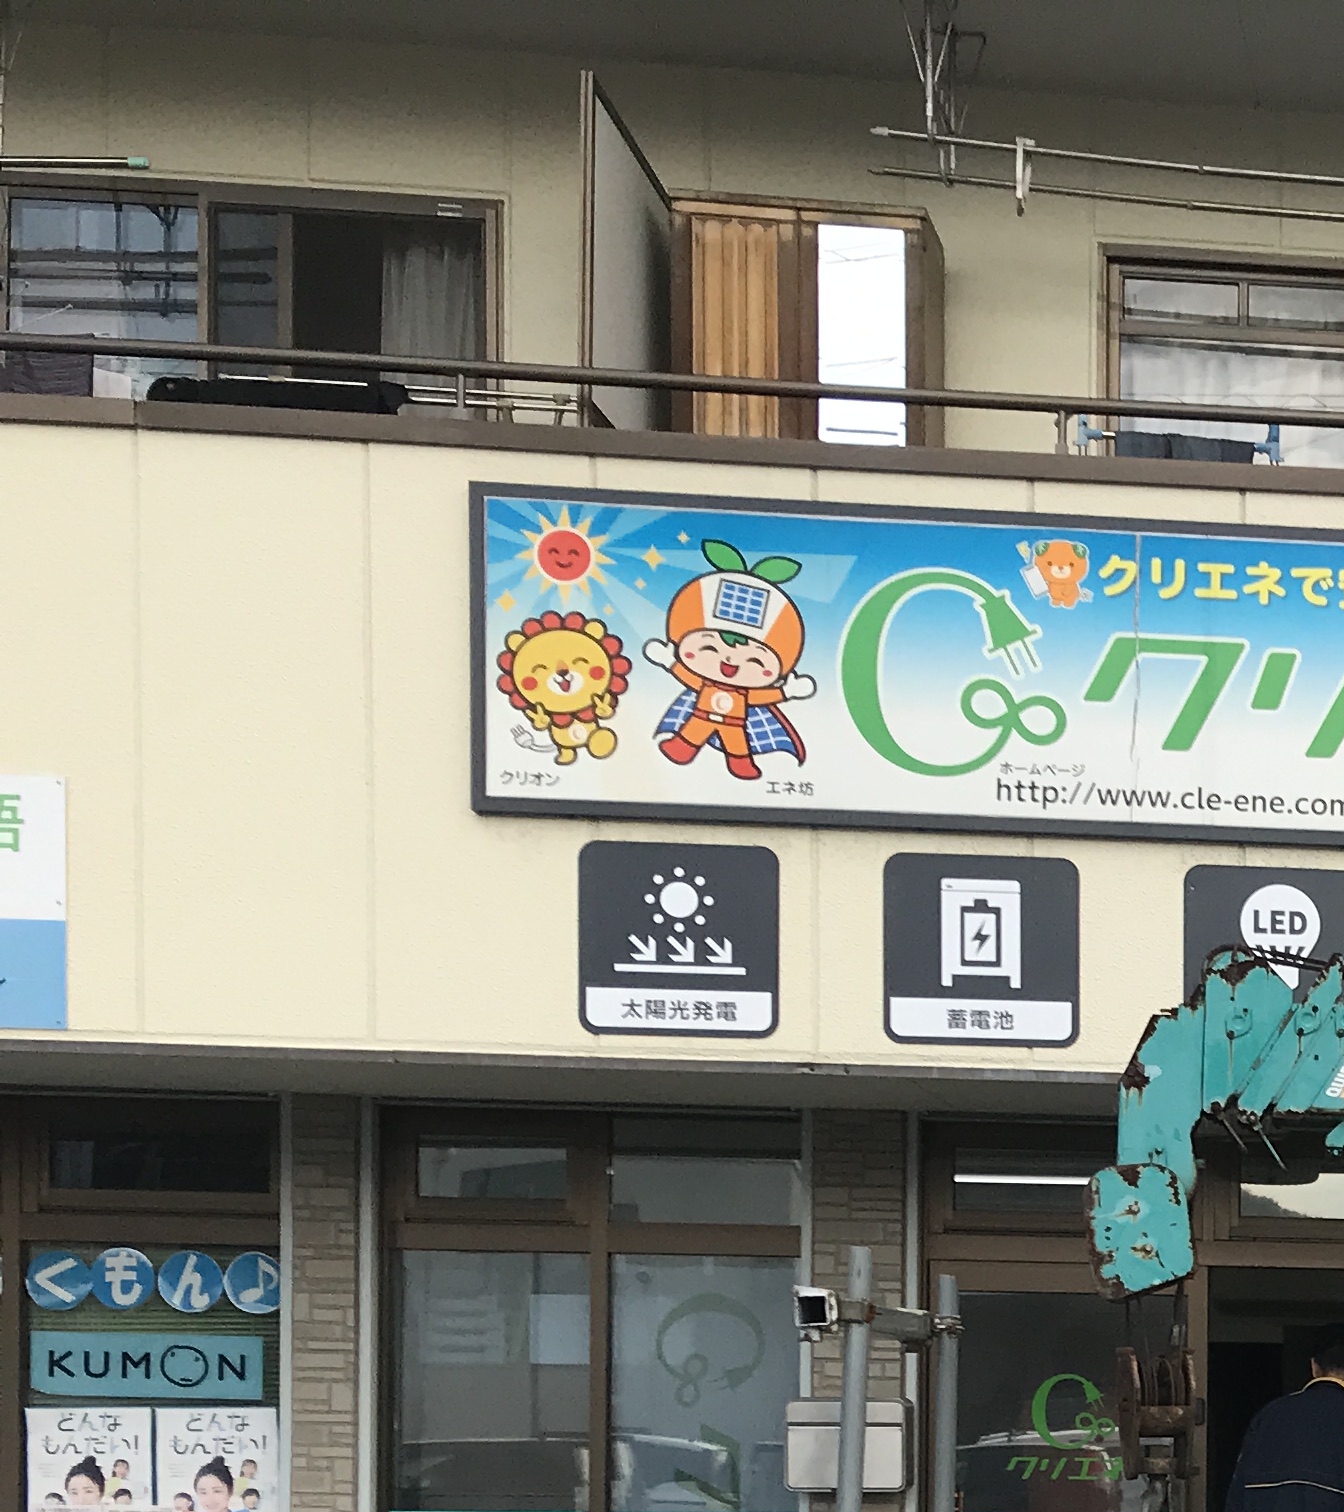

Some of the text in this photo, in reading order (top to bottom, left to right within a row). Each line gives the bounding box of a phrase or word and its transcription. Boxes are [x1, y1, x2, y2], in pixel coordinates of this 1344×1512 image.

[499, 769, 560, 787] クリオン
[999, 762, 1085, 778] ホームページ
[766, 780, 814, 797] エネ坊
[1253, 909, 1308, 935] LED
[621, 999, 738, 1023] 太陽光発電
[946, 1008, 1015, 1031] 蓄電池
[34, 1252, 210, 1308] くもん
[48, 1345, 248, 1388] KUMON
[57, 1412, 123, 1432] どんな
[186, 1412, 250, 1432] どんな
